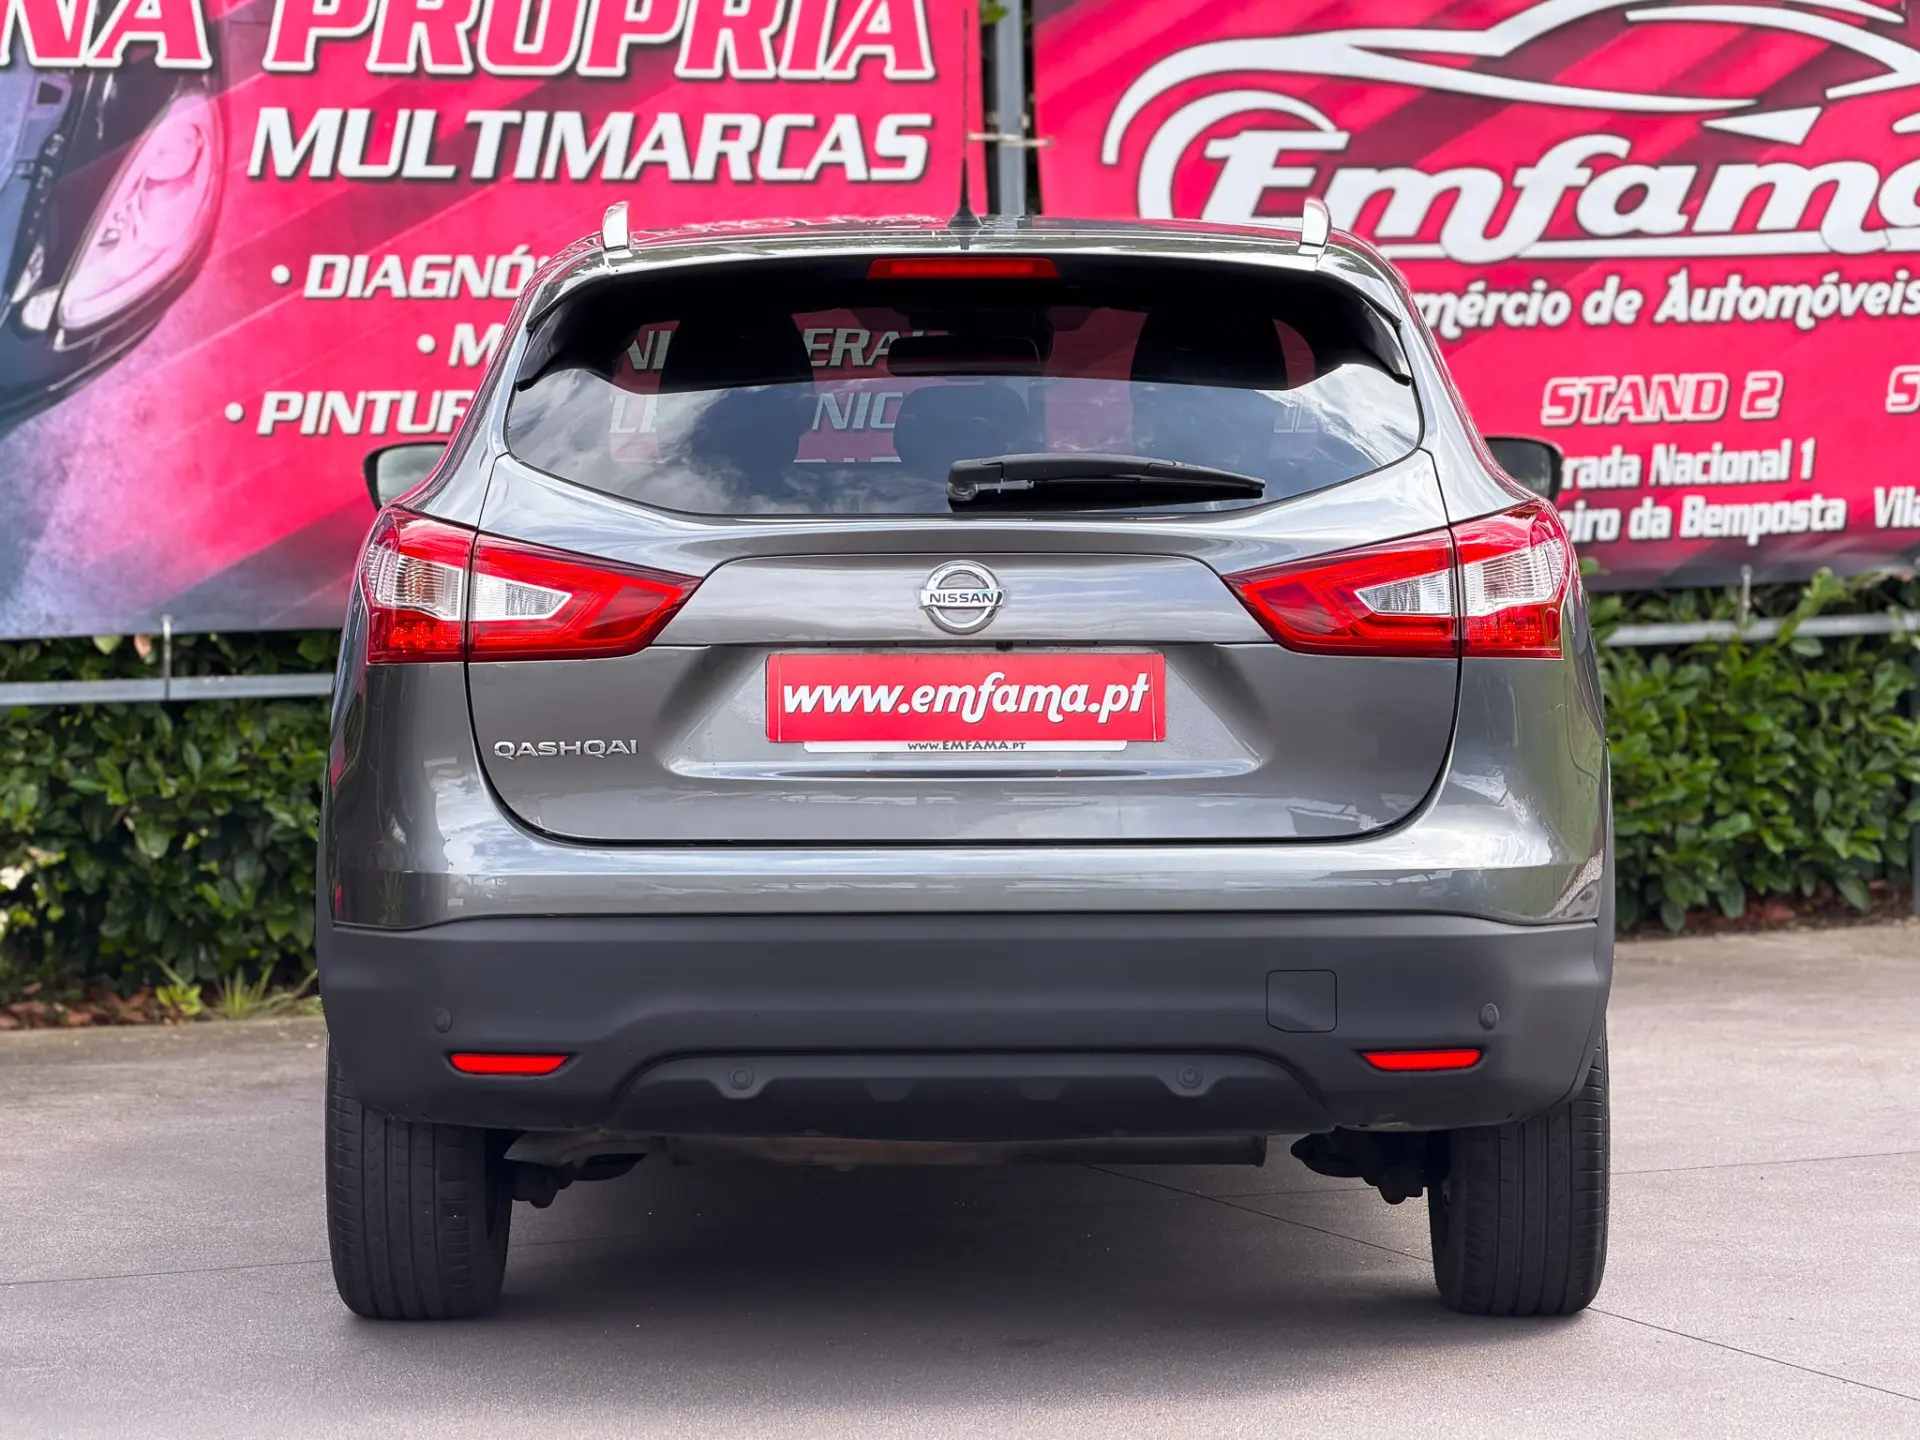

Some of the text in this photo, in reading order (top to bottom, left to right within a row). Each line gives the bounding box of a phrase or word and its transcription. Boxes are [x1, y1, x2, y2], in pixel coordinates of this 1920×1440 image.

[246, 106, 933, 182] MULTIMARCAS
[303, 245, 549, 299] DIAGNÓ
[1413, 267, 1920, 340] mércio de Automóveis
[803, 328, 925, 367] ERA
[256, 390, 475, 436] PINTUR
[1540, 370, 1784, 426] STAND 2
[1561, 437, 1816, 490] rada Nacional 1
[1559, 493, 1847, 546] eiro da Bemposta
[928, 592, 995, 604] NISSAN
[783, 672, 1150, 724] www.emfama.pt
[494, 739, 637, 760] QASHQAI
